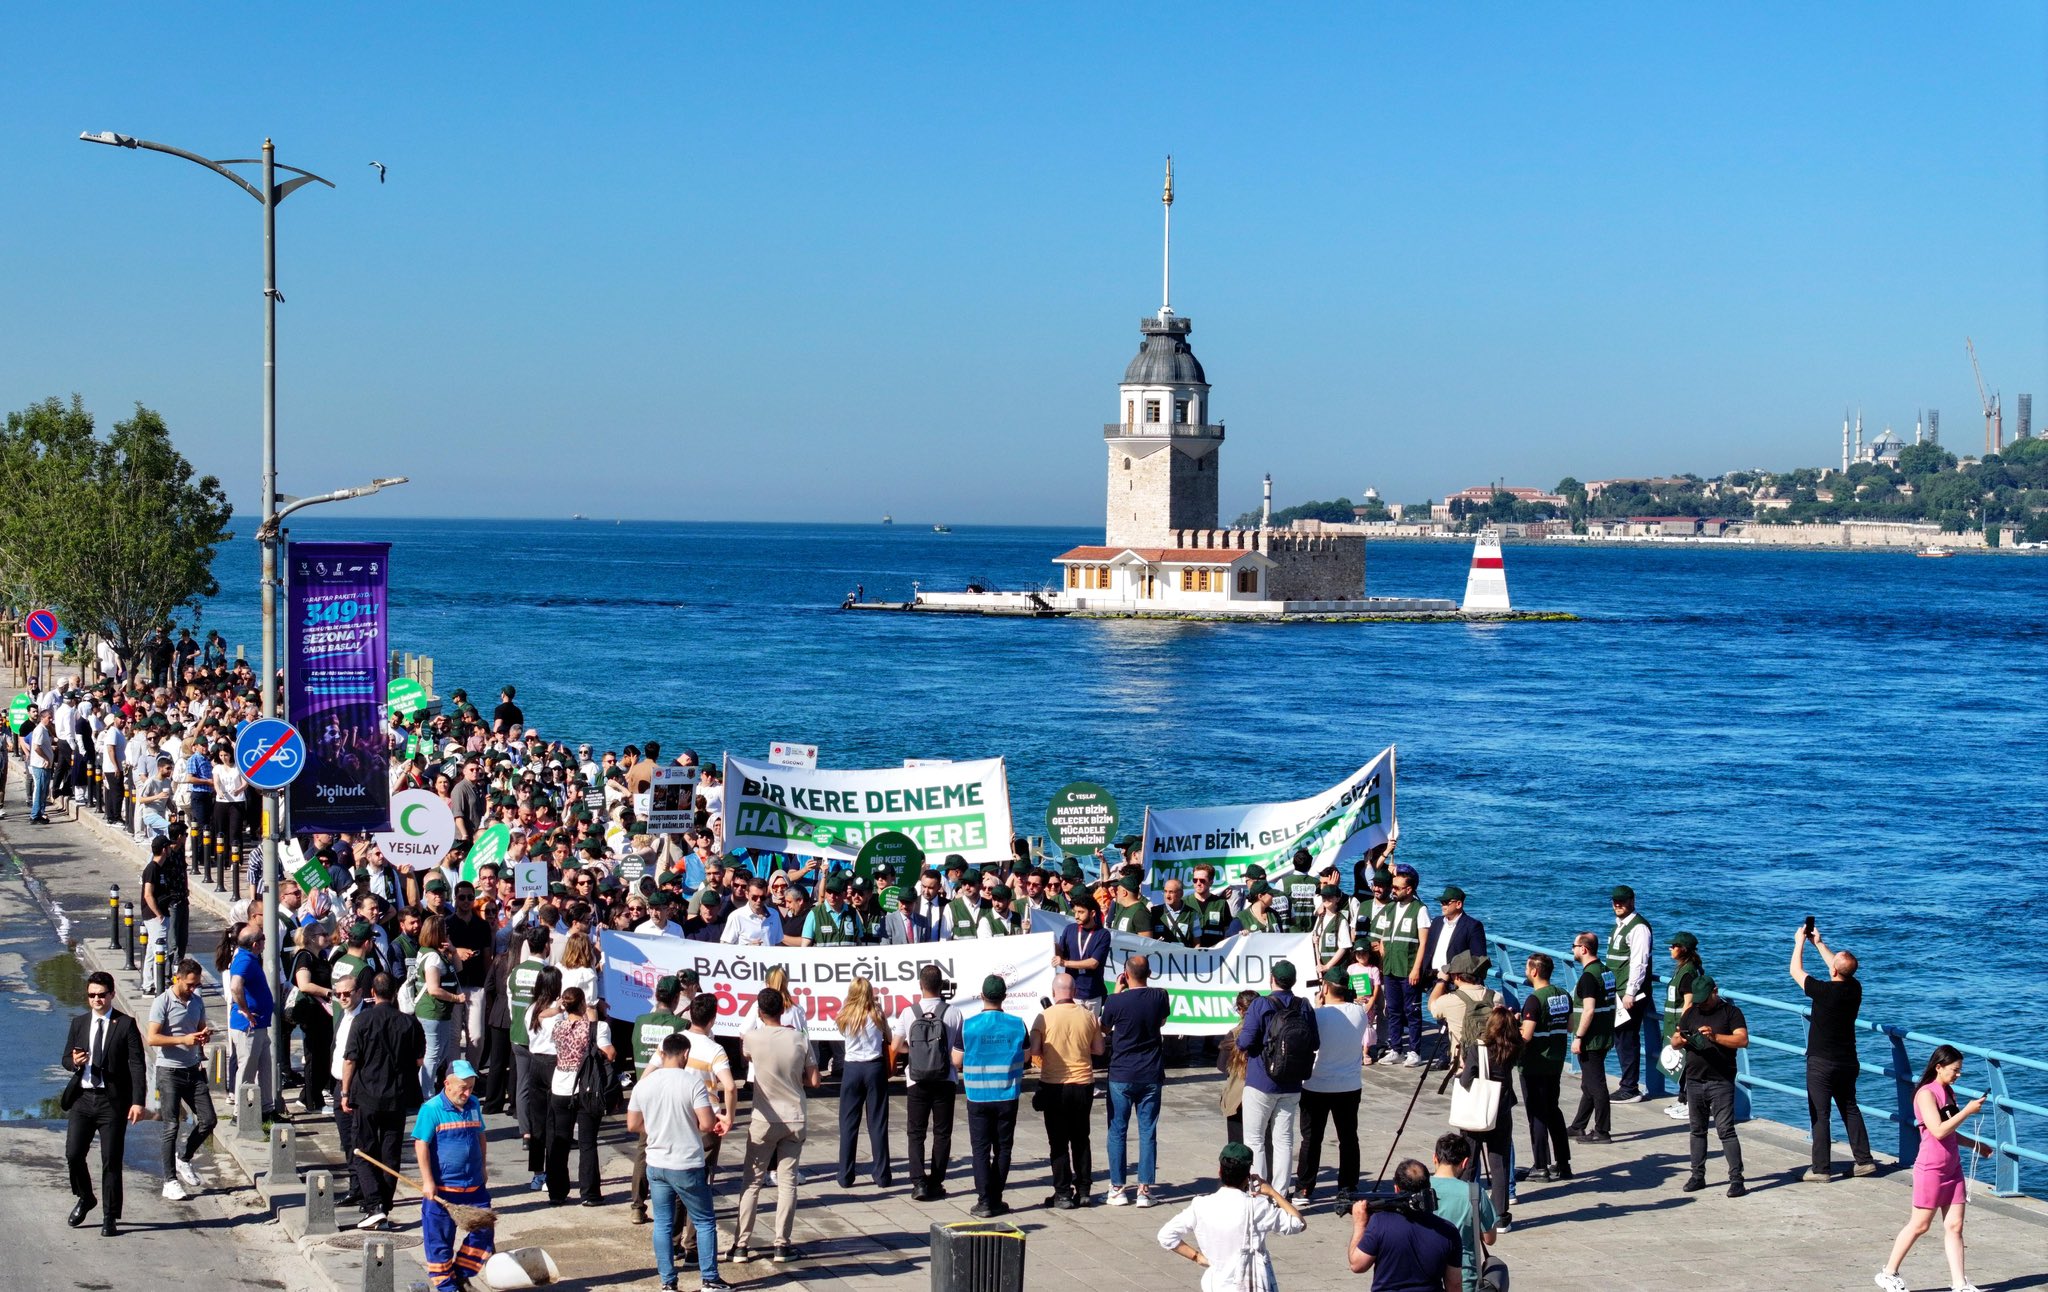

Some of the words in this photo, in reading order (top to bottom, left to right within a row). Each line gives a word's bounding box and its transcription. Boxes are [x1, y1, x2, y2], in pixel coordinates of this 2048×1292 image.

[302, 600, 358, 626] 349
[302, 630, 356, 644] SEZONA
[358, 628, 378, 640] 1-0
[302, 646, 327, 654] ÖNDE
[328, 642, 360, 652] BAŞLA!
[316, 784, 366, 804] Digiturk
[742, 776, 786, 807] BİR
[790, 786, 859, 814] KERE
[865, 782, 984, 814] DENEME
[1057, 806, 1084, 815] HAYAT
[1085, 804, 1108, 814] BİZİM
[1052, 816, 1090, 826] GELECEK
[1090, 814, 1114, 824] BİZİM
[909, 820, 984, 851] KERE
[1060, 826, 1106, 834] MÜCADELE
[1061, 834, 1105, 845] HEPİMİZİN!
[1153, 834, 1202, 854] HAYAT
[1205, 828, 1255, 850] BİZİM,
[885, 855, 906, 864] KERE
[694, 954, 806, 982] BAĞIMLI
[814, 956, 955, 983] DEĞİLSEN
